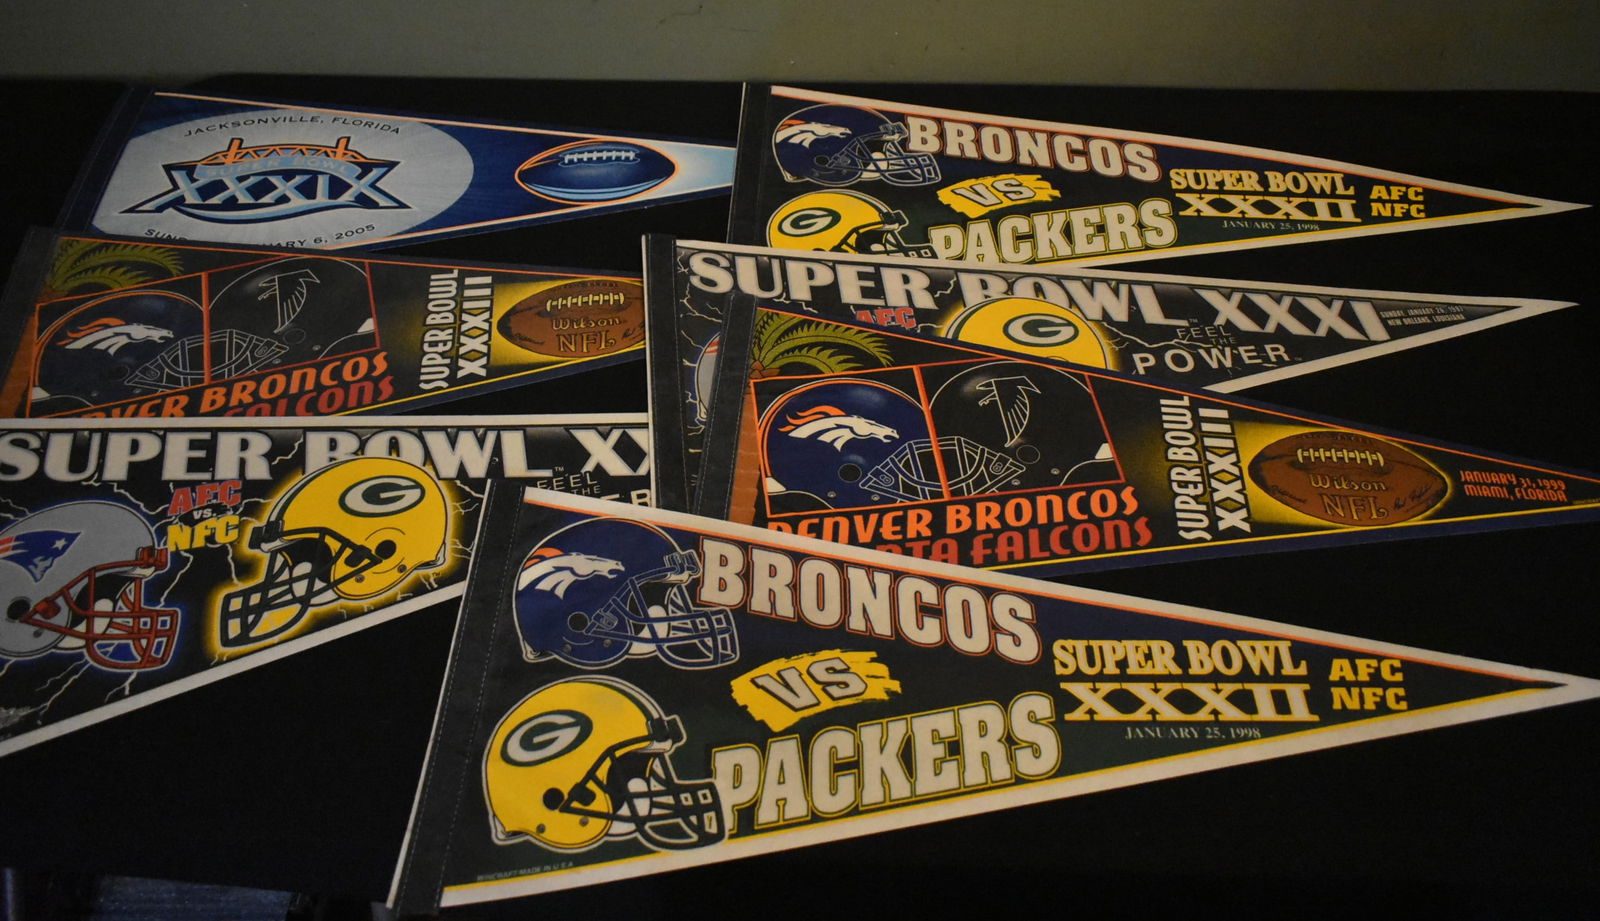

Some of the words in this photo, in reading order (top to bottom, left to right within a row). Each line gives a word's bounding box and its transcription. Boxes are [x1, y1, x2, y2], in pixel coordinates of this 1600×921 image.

[184, 115, 324, 137] JACKSONVILLE,
[331, 116, 401, 135] FLORIDA
[903, 114, 1162, 182] BRONCOS
[205, 158, 280, 177] SUPER
[294, 156, 349, 174] BOWL
[1170, 169, 1264, 192] SUPER
[1265, 171, 1355, 195] BOWL
[134, 166, 401, 212] XXXIX
[951, 177, 1038, 207] VS
[1370, 185, 1424, 201] AFC
[1175, 193, 1361, 222] XXXII
[1371, 203, 1425, 218] NFC
[313, 234, 329, 244] 6,
[335, 223, 376, 240] 2005
[928, 198, 1178, 264] PACKERS
[1222, 219, 1277, 231] JANUARY
[1279, 222, 1294, 231] 25,
[1296, 222, 1320, 231] 1998
[426, 269, 459, 326] BOWL
[689, 252, 939, 311] SUPER
[1193, 287, 1391, 342] XXXI
[456, 276, 493, 379] XXXIII
[552, 317, 621, 330] Wilson
[856, 307, 917, 329] AFC
[1175, 324, 1232, 339] FEEL
[556, 330, 617, 353] NFL
[1210, 337, 1239, 346] THE
[419, 328, 456, 391] SUPER
[1131, 343, 1291, 375] POWER
[200, 352, 388, 414] BRONCOS
[1160, 396, 1200, 462] BOWL
[0, 431, 273, 481] SUPER
[1198, 408, 1252, 533] XXXIII
[1308, 474, 1388, 491] Wilson
[1460, 470, 1517, 485] JANUARY
[1519, 477, 1536, 488] 31,
[1538, 478, 1566, 490] 1999
[1463, 484, 1514, 501] MIAMI,
[1514, 487, 1568, 502] FLORIDA
[167, 480, 242, 517] AFC
[946, 486, 1139, 534] BRONCOS
[1170, 465, 1213, 541] SUPER
[1320, 494, 1390, 520] NFL
[167, 515, 240, 552] NFC
[970, 516, 1154, 566] FALCONS
[698, 537, 1042, 664] BRONCOS
[1052, 639, 1183, 676] SUPER
[1183, 639, 1308, 676] BOWL
[1329, 658, 1404, 682] AFC
[751, 657, 869, 713] VS
[1331, 687, 1408, 711] NFC
[1059, 682, 1320, 722] XXXII
[1124, 727, 1201, 740] JANUARY
[1204, 727, 1226, 741] 25,
[1230, 726, 1262, 739] 1998
[712, 691, 1062, 833] PACKERS
